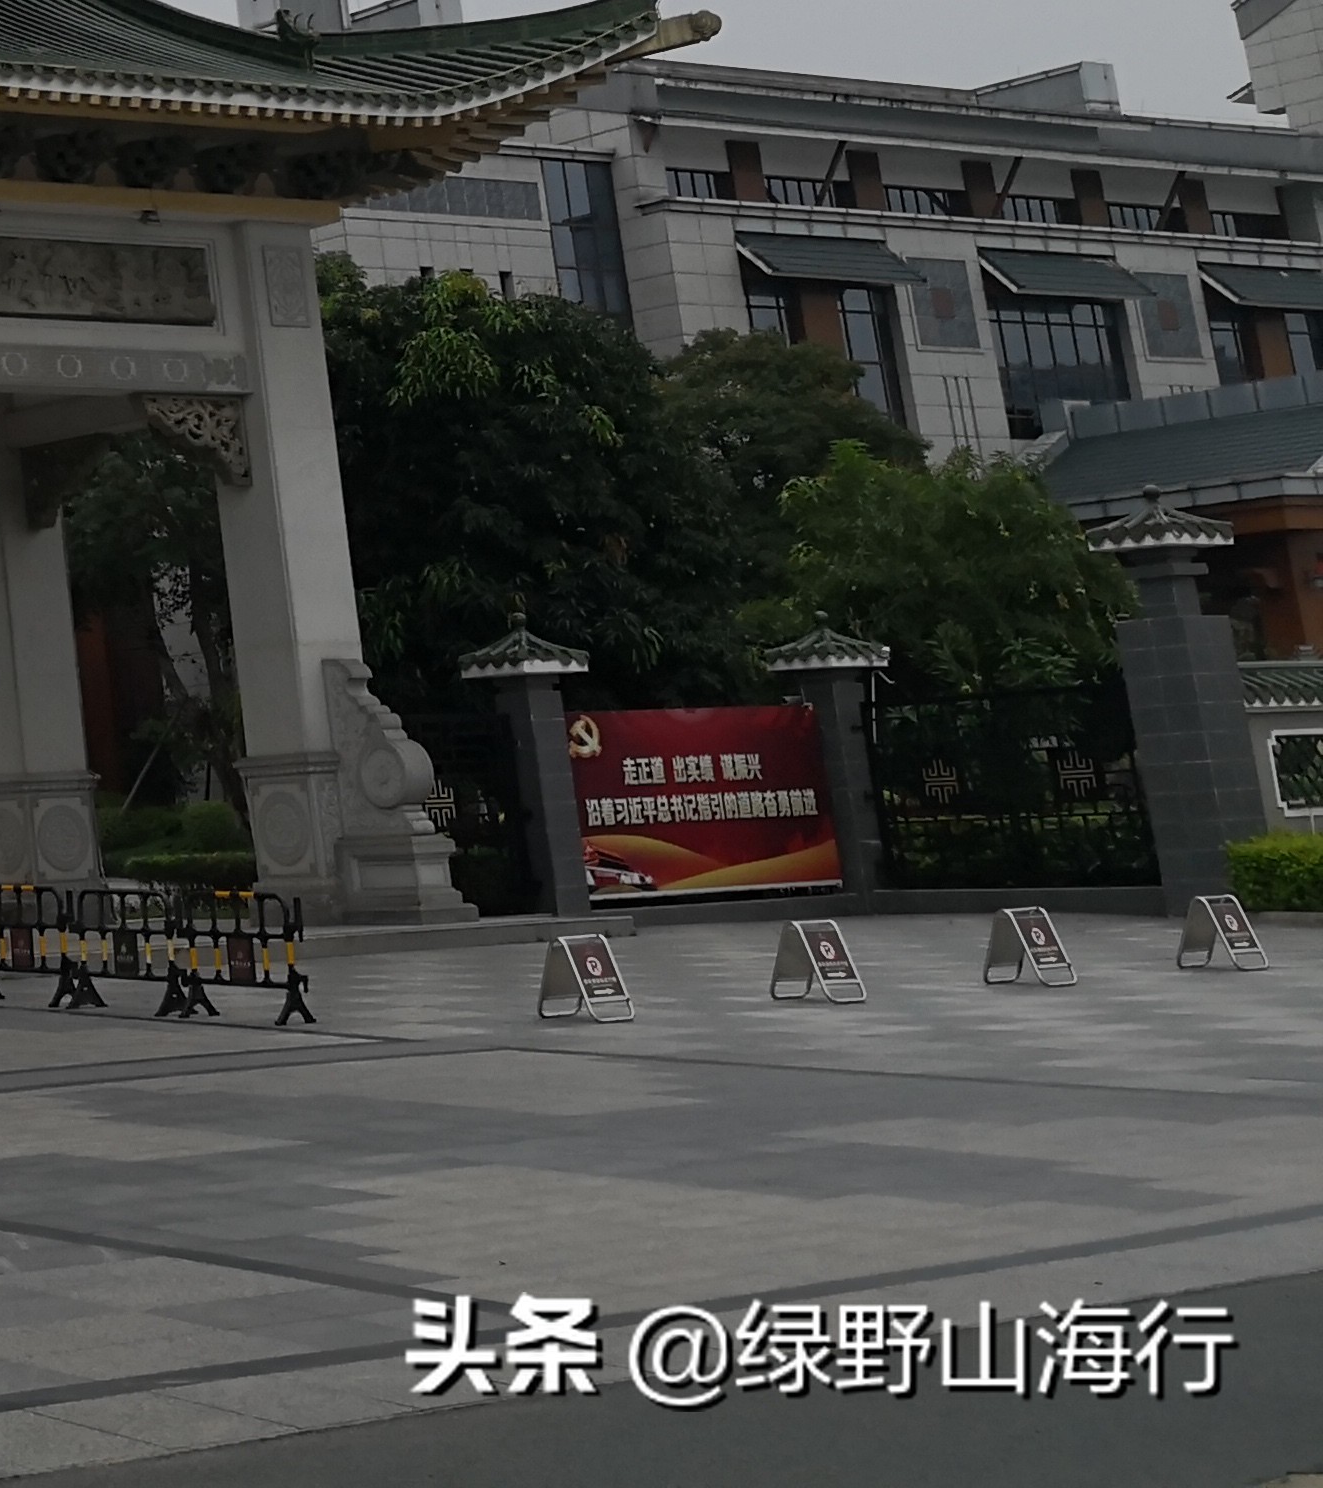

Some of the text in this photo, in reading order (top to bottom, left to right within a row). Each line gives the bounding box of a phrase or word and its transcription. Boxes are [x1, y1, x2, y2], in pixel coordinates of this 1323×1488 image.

[622, 755, 665, 785] 走正道
[672, 754, 716, 784] 出实绩
[585, 788, 818, 826] 沿着习近平总书记指引的道路奋勇前进
